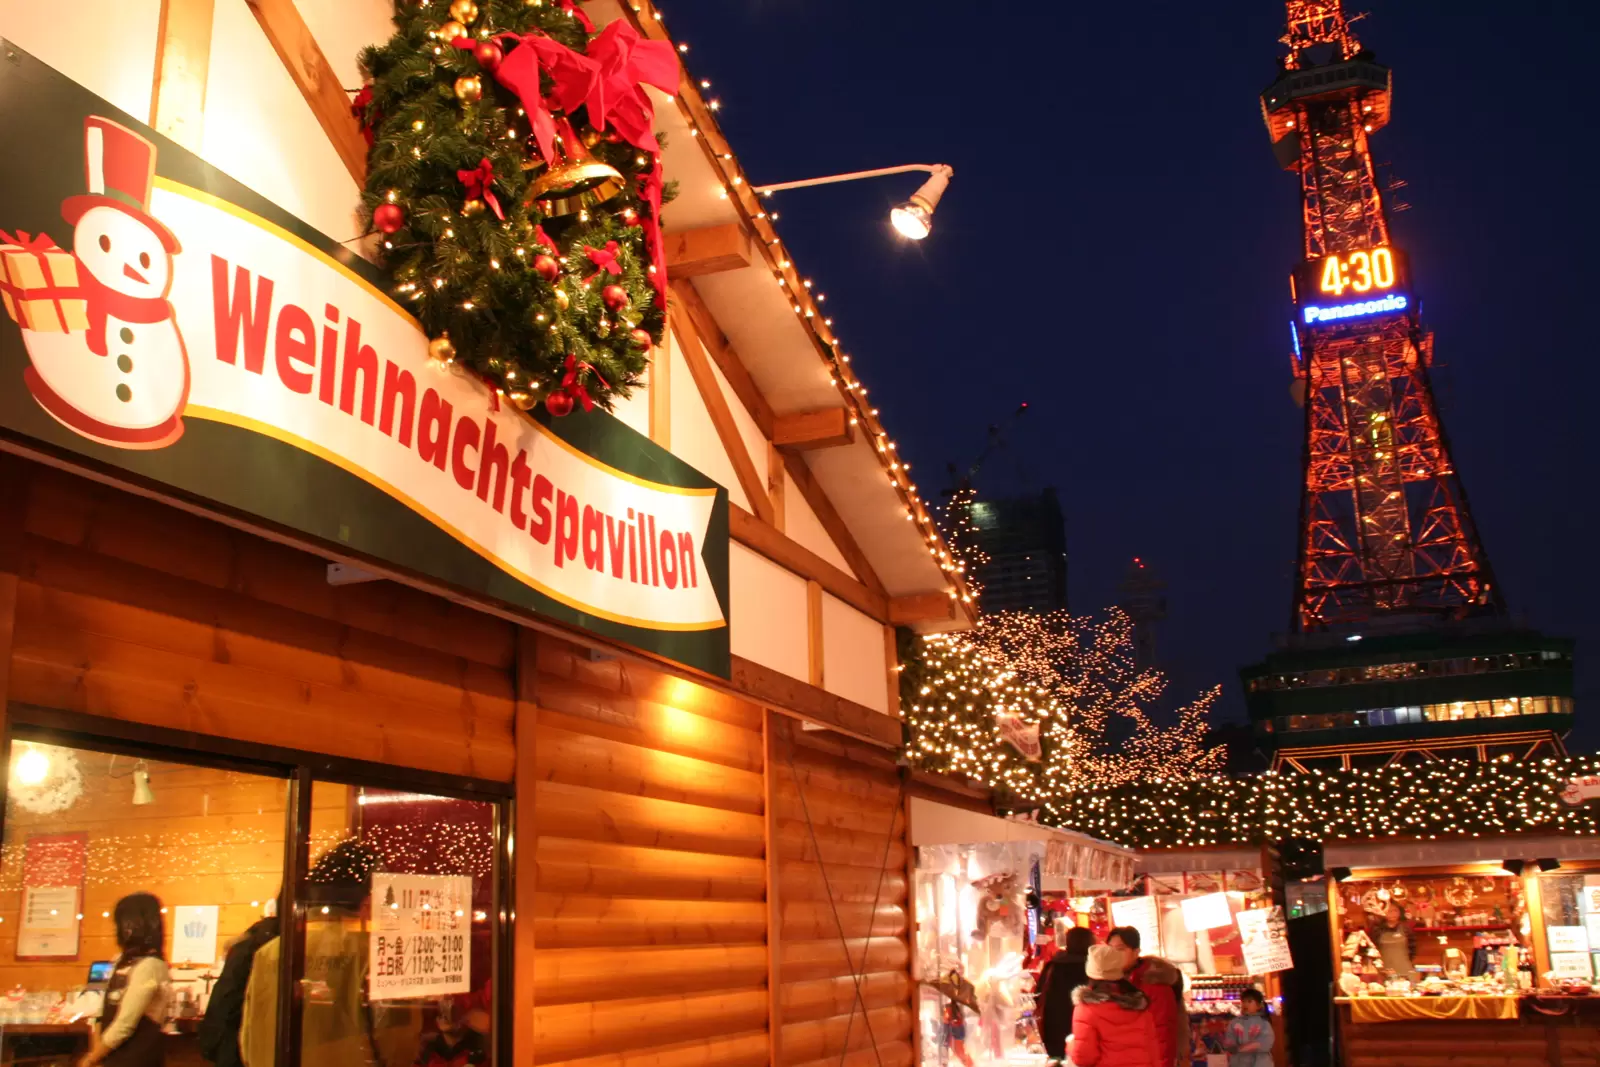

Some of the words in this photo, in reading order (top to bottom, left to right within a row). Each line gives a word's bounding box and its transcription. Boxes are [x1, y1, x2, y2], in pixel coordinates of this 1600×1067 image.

[1321, 248, 1394, 295] 4:30
[1304, 295, 1407, 322] Panasonic
[210, 253, 698, 591] Weihnachtspavillon
